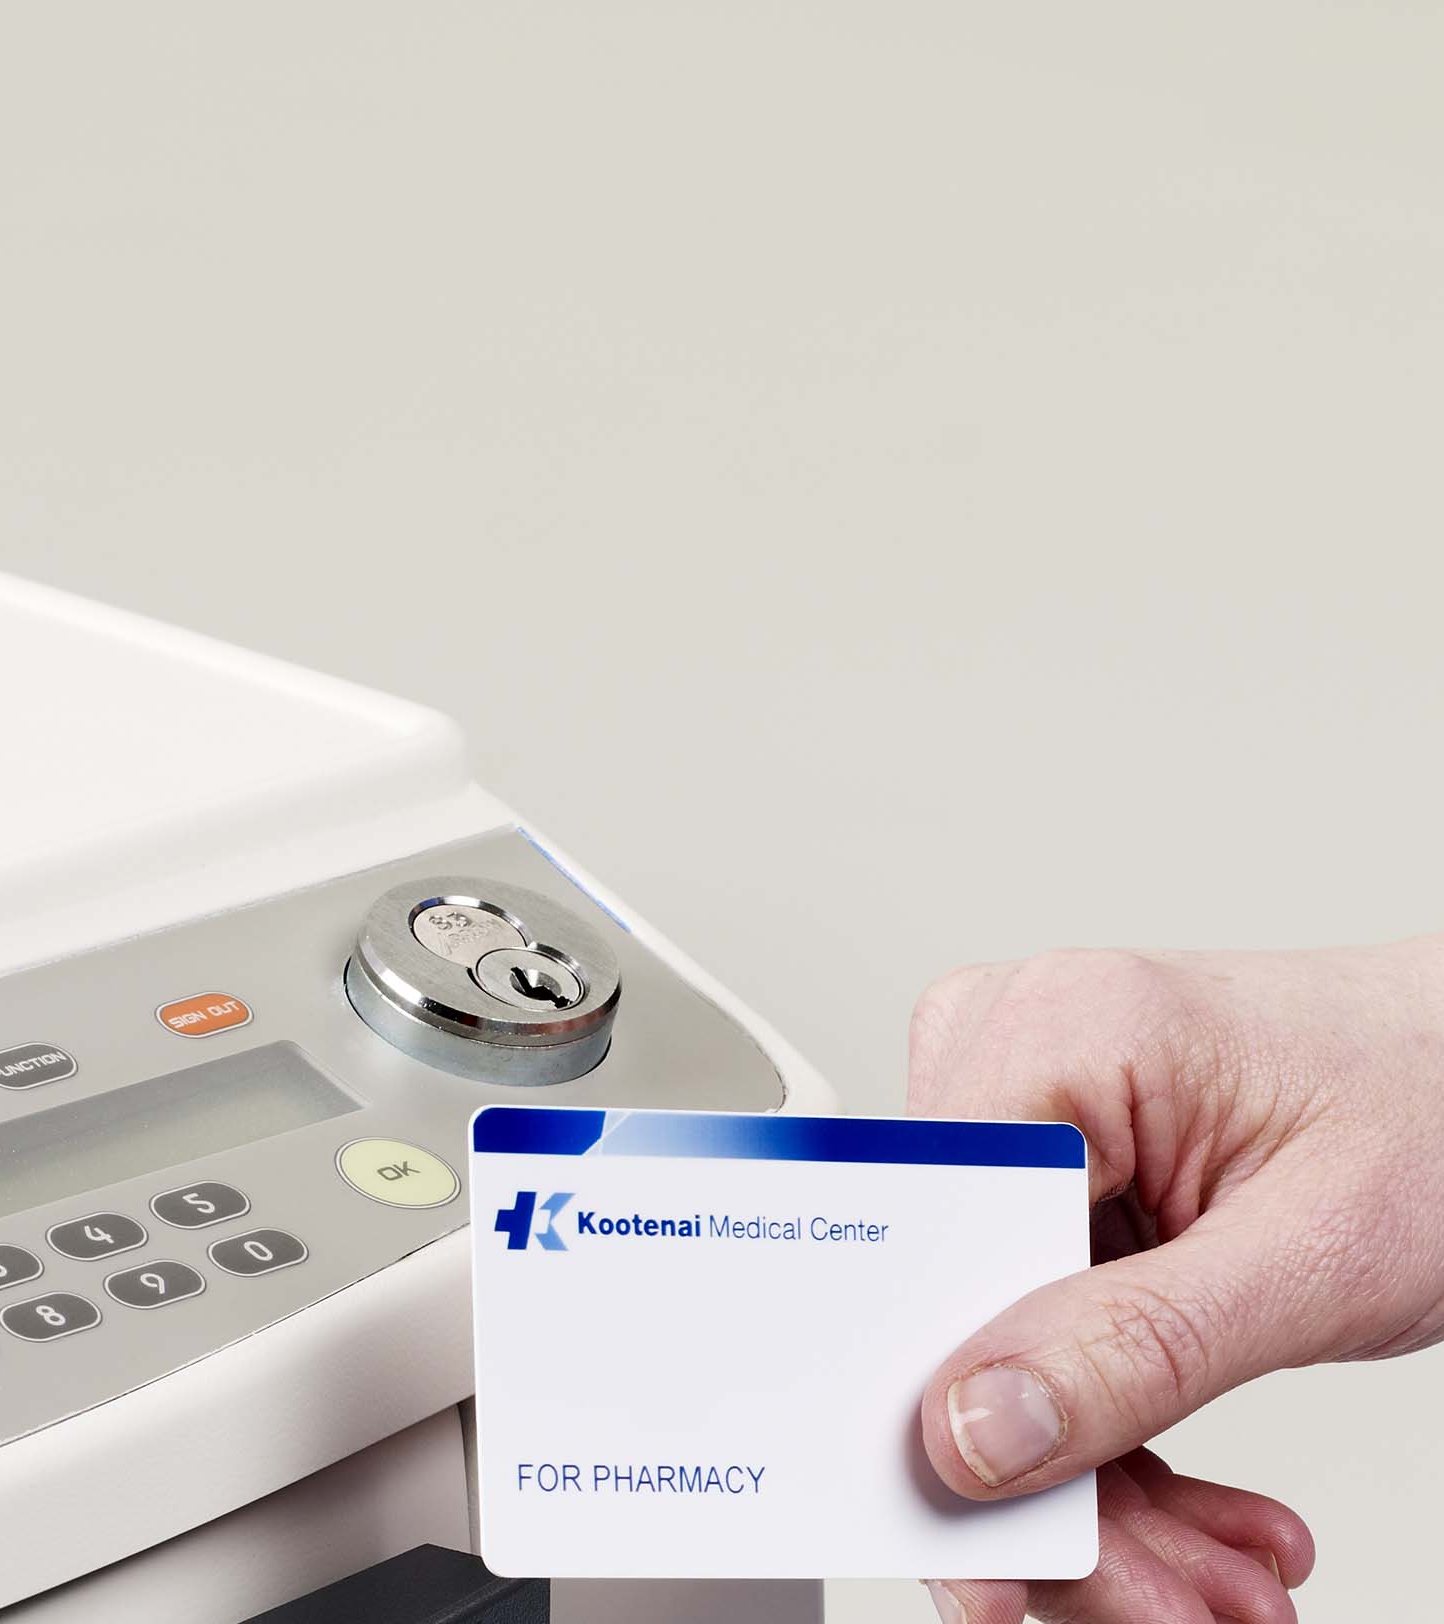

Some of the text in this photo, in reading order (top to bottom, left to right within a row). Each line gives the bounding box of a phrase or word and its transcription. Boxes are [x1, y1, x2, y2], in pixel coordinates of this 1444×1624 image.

[168, 1000, 241, 1030] SIGN OUT
[377, 1160, 419, 1182] OK
[183, 1192, 216, 1214] 5
[84, 1224, 115, 1245] 4
[577, 1211, 702, 1237] Kootenai
[708, 1215, 802, 1241] Medical
[809, 1216, 890, 1243] Center
[243, 1240, 272, 1262] 0
[140, 1272, 166, 1295] 9
[35, 1304, 66, 1327] 8
[518, 1463, 766, 1494] FOR PHARMACY
